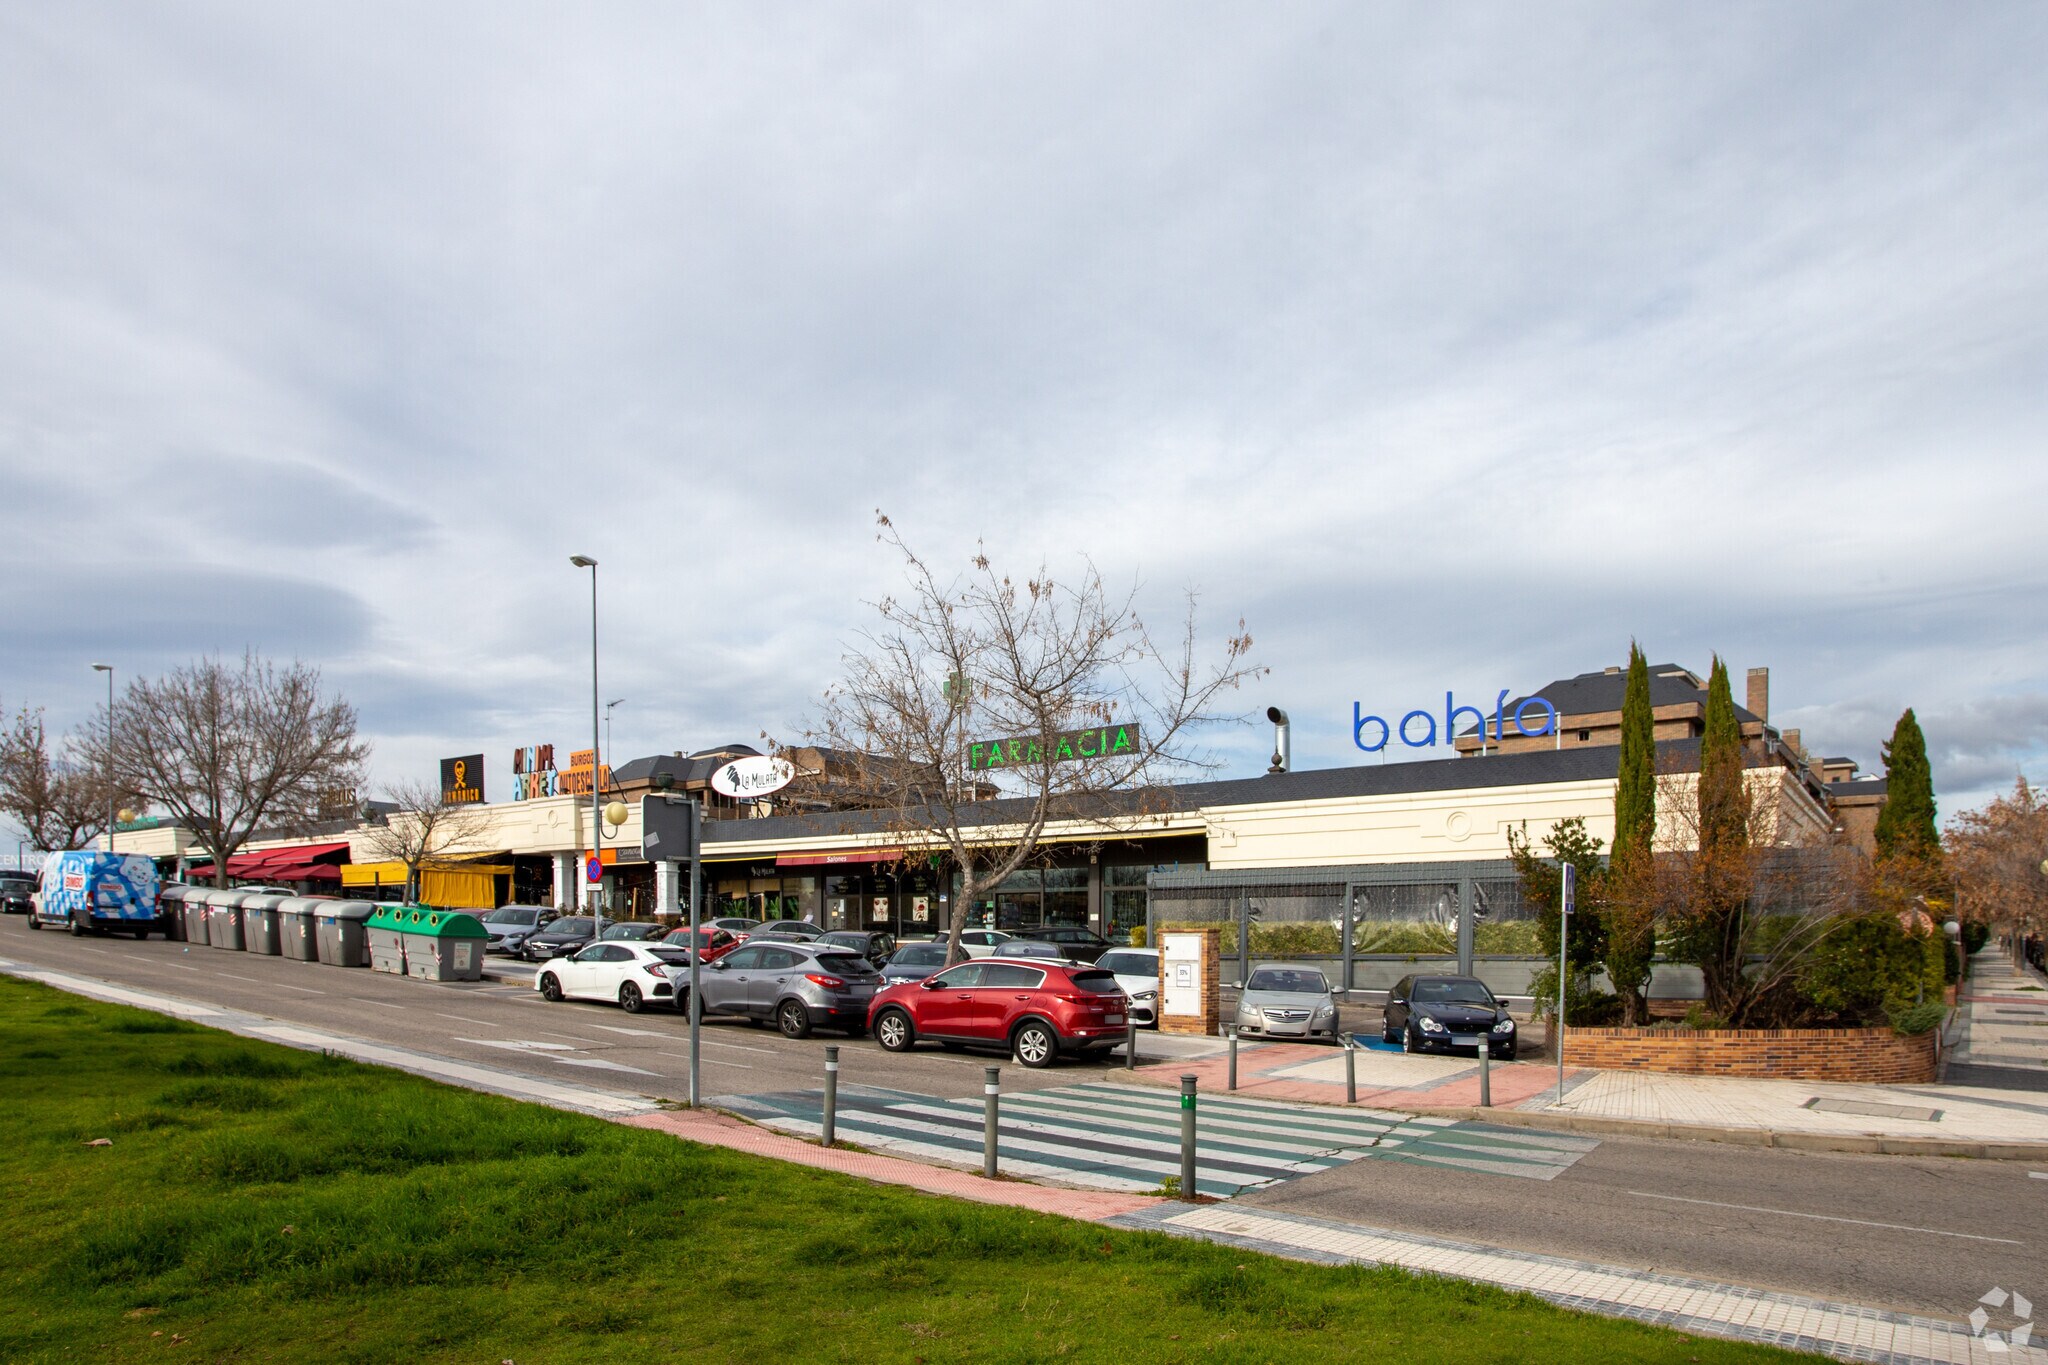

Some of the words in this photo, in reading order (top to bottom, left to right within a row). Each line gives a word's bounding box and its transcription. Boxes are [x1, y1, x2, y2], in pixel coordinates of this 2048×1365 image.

[1353, 689, 1555, 752] bahía
[971, 726, 1131, 769] FARMACIA
[559, 768, 608, 795] AUTOESCULA
[65, 876, 83, 888] BIMBO
